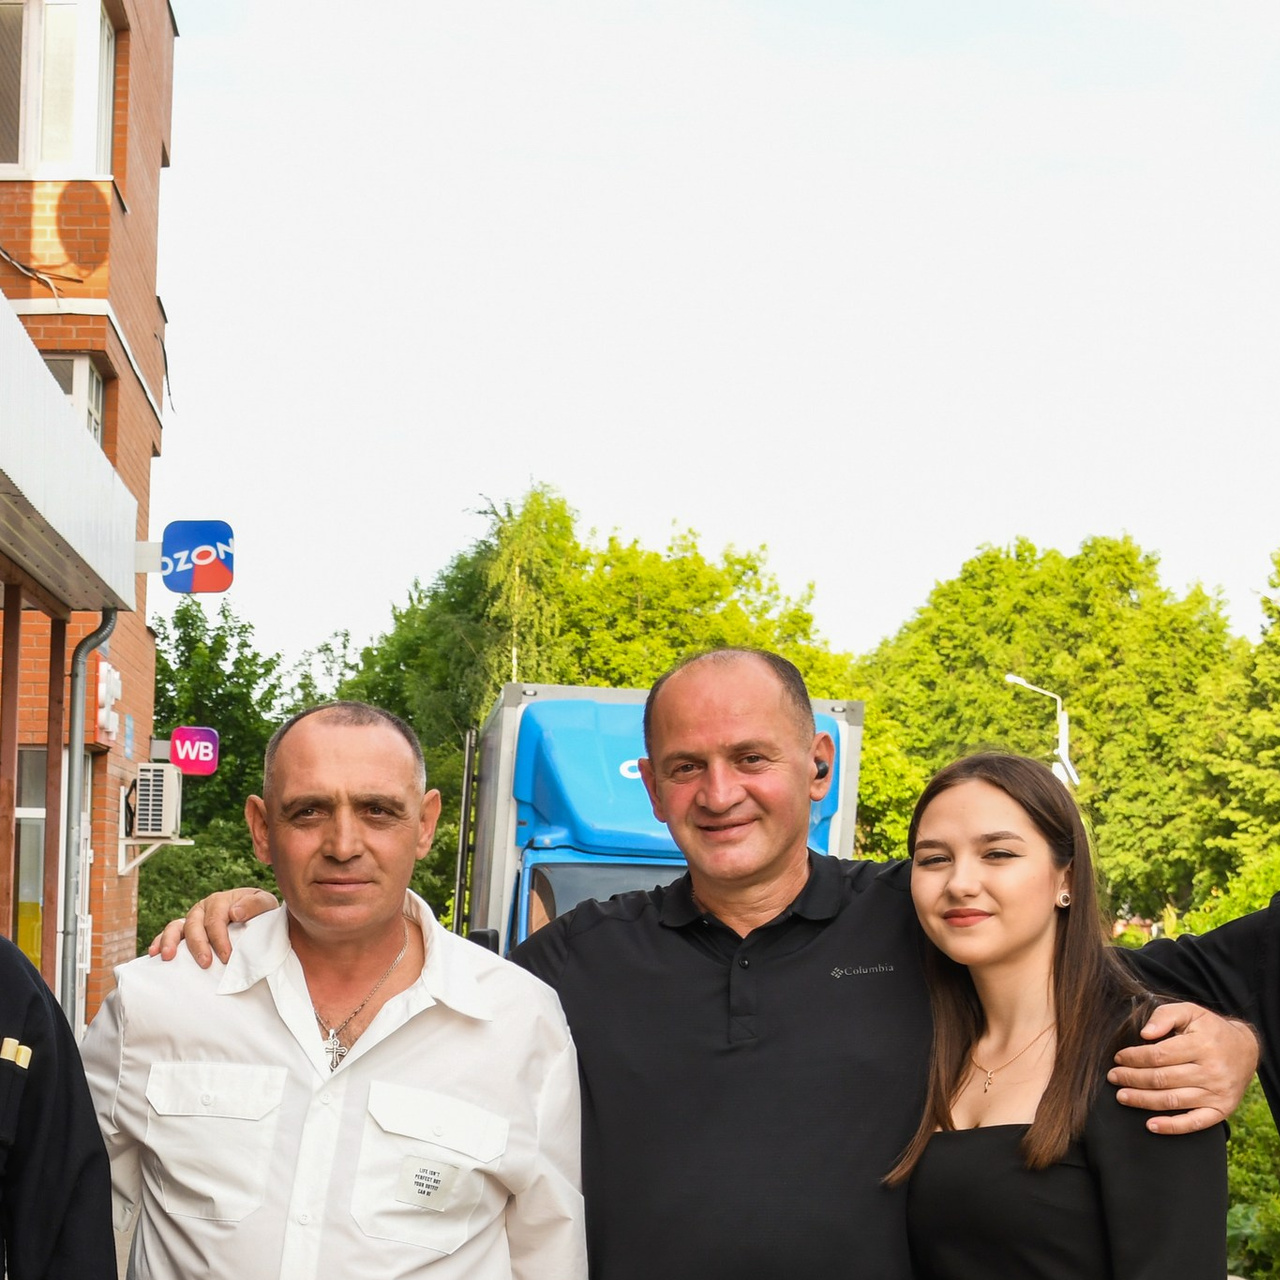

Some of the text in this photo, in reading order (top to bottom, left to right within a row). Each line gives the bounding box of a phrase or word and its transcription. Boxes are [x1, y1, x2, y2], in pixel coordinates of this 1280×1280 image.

[175, 739, 214, 761] WB
[844, 963, 894, 975] Columbia
[415, 1174, 432, 1182] PERFECT
